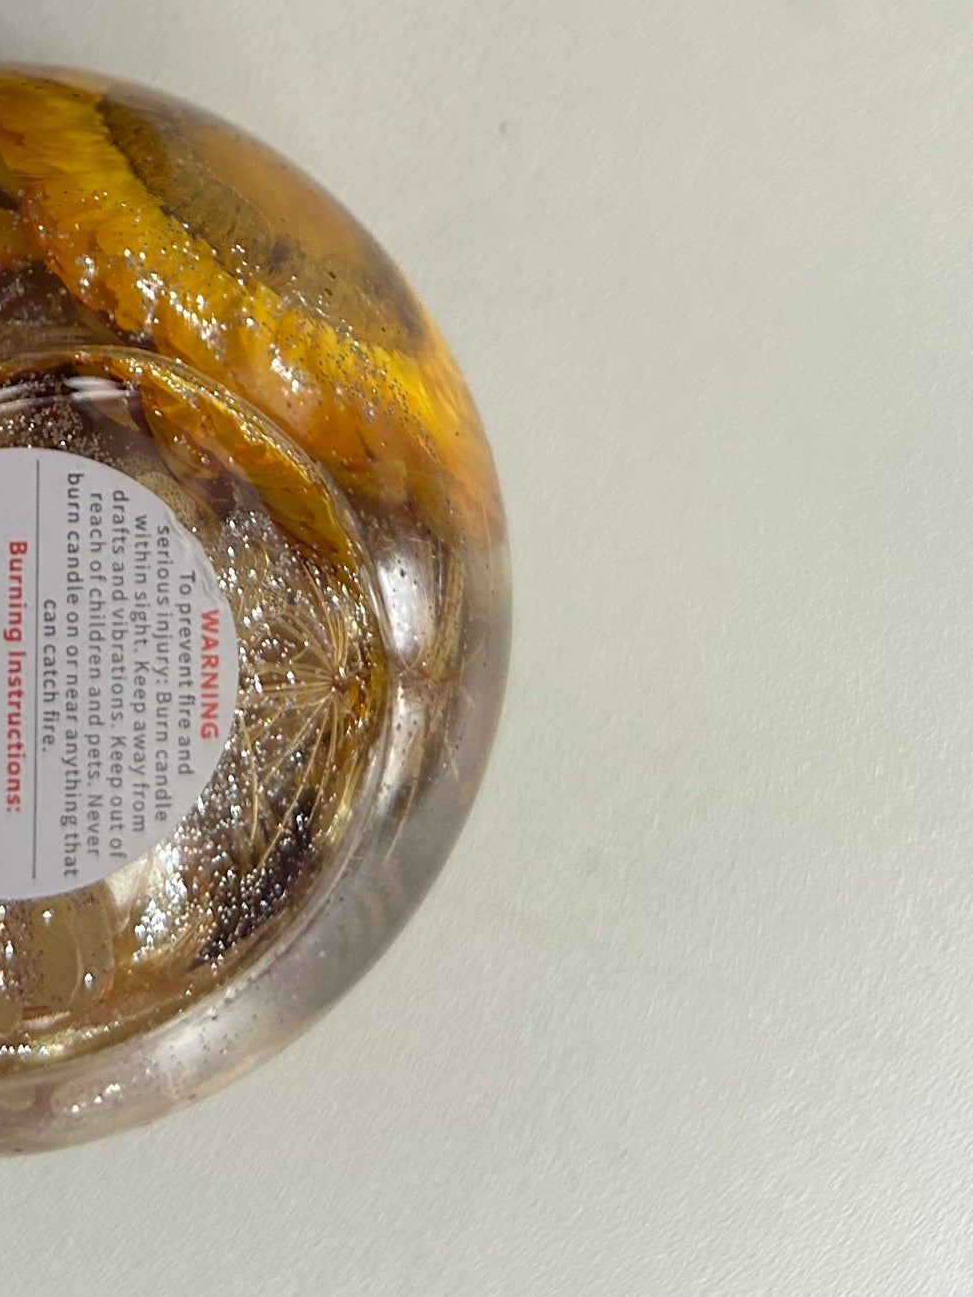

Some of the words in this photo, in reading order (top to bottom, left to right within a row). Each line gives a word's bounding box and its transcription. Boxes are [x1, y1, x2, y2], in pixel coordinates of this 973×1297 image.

[67, 472, 85, 524] burn
[89, 492, 107, 553] reach
[111, 489, 130, 555] drafts
[66, 530, 84, 605] candle
[89, 560, 108, 582] of
[134, 514, 152, 584] within
[156, 525, 174, 606] serious
[2, 540, 28, 643] Burning
[111, 561, 129, 602] and
[178, 569, 197, 596] To
[43, 599, 57, 637] can
[66, 611, 79, 638] on
[88, 587, 106, 680] children
[129, 591, 152, 653] sight.
[65, 644, 79, 668] or
[110, 607, 129, 728] vibrations.
[151, 612, 174, 684] injury:
[174, 603, 194, 688] prevent
[42, 644, 60, 703] catch
[65, 674, 79, 723] near
[129, 660, 150, 714] Keep
[200, 608, 220, 740] WARNING
[6, 651, 27, 813] Instructions:
[41, 710, 61, 752] fire.
[88, 686, 105, 727] and
[155, 691, 172, 742] Burn
[177, 694, 196, 730] fire
[83, 734, 103, 786] pets.
[105, 735, 127, 789] Keep
[128, 721, 146, 776] away
[177, 736, 195, 775] and
[59, 729, 82, 827] anything
[154, 749, 173, 822] candle
[86, 794, 103, 856] Never
[109, 795, 125, 831] out
[132, 782, 151, 832] from
[63, 832, 82, 877] that
[109, 837, 127, 859] of
